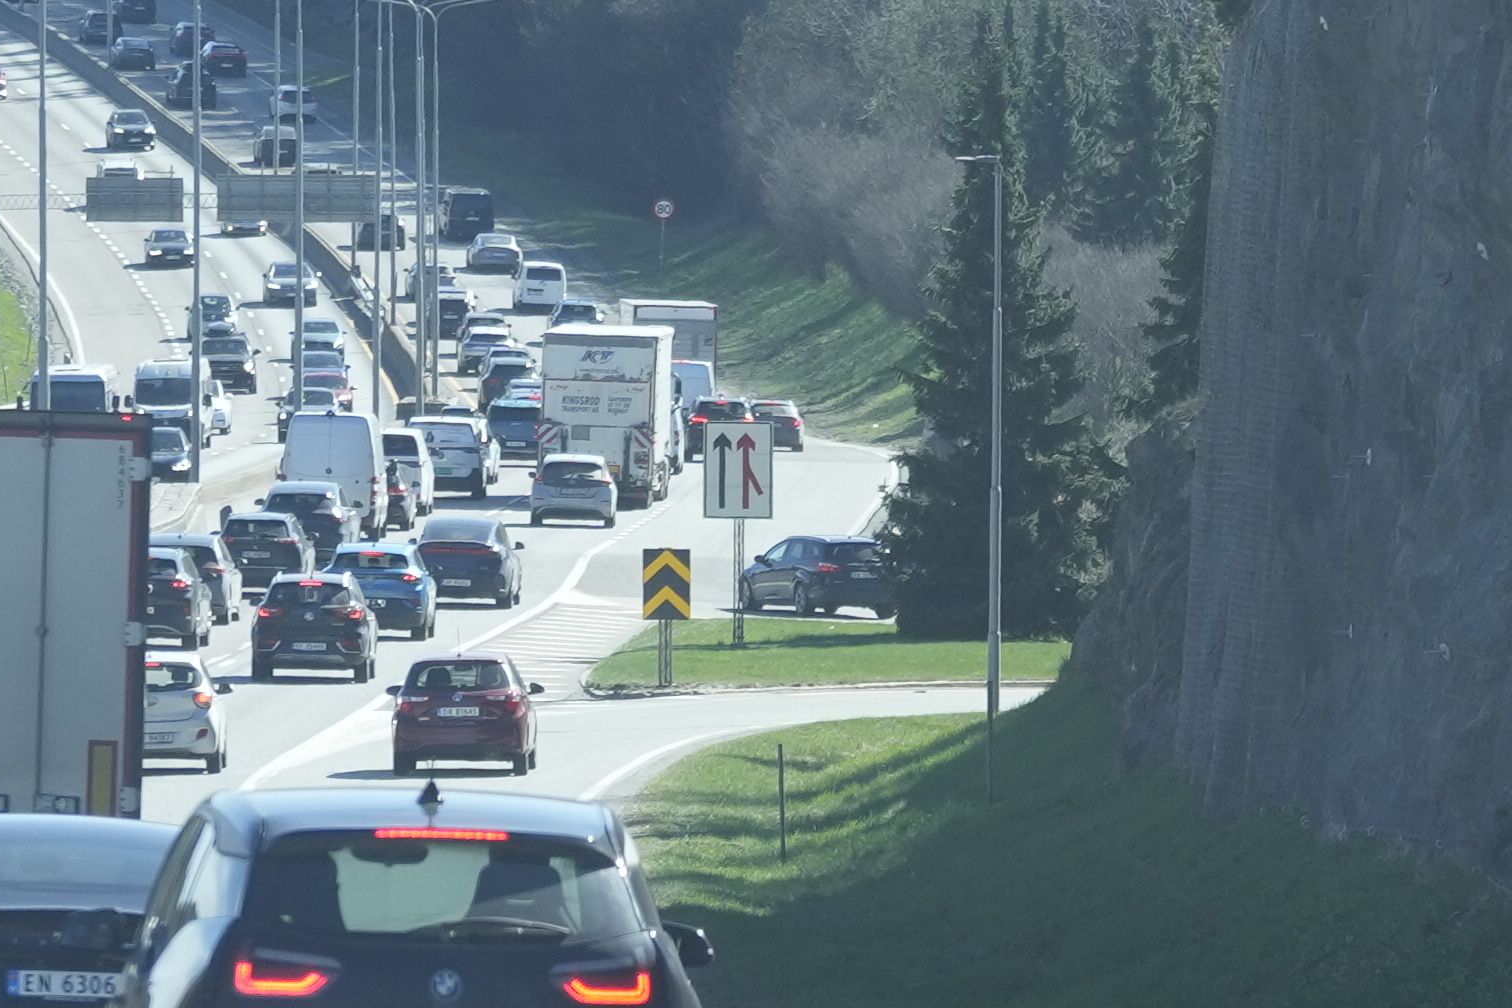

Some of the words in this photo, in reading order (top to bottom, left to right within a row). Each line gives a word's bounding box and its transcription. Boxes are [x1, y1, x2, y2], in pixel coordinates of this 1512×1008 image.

[657, 204, 671, 215] 80
[24, 974, 52, 993] EN
[62, 975, 116, 995] 6306
